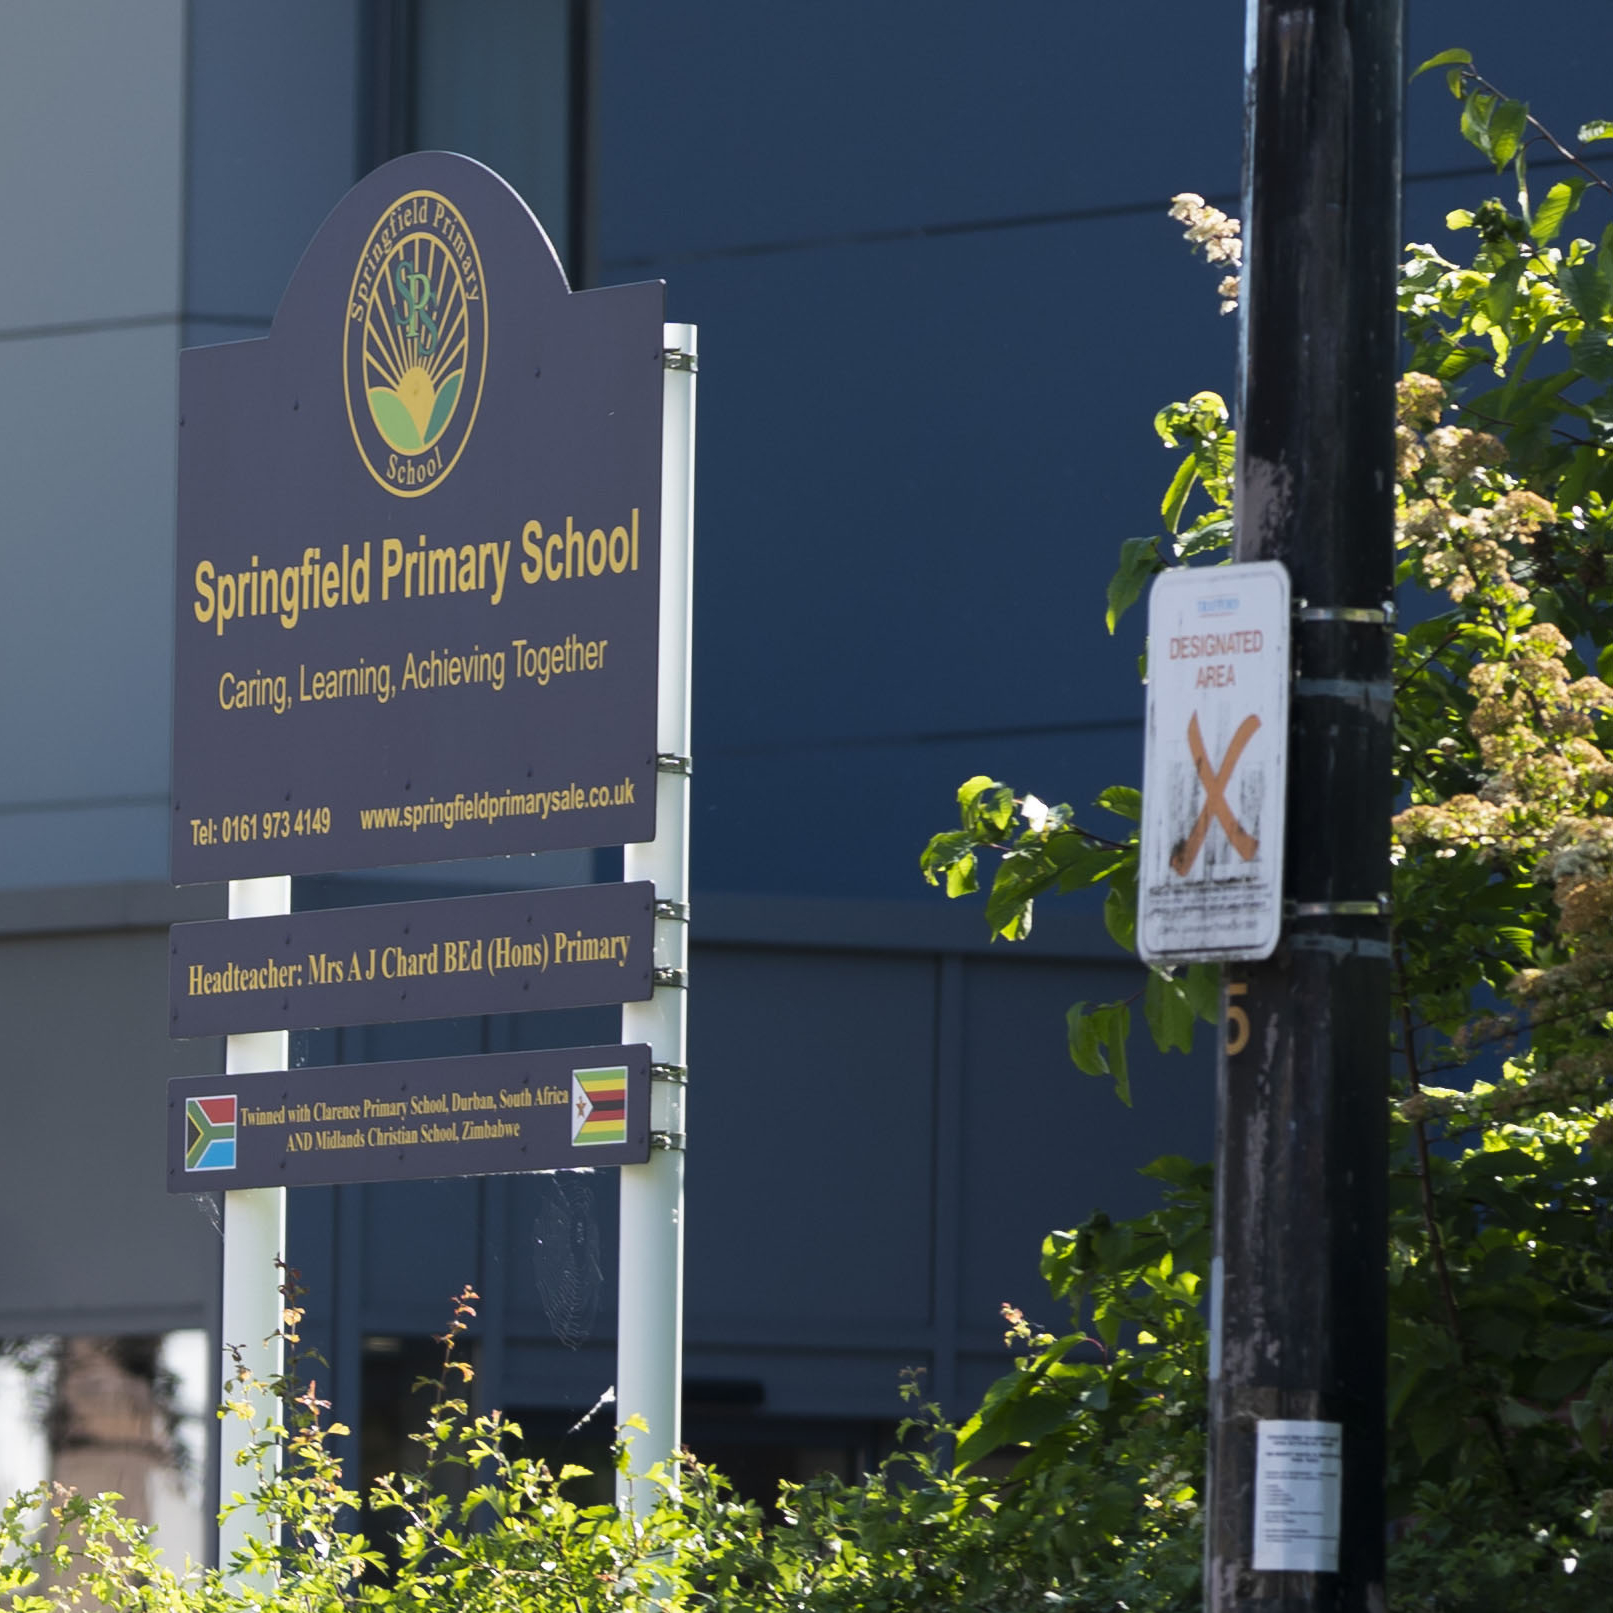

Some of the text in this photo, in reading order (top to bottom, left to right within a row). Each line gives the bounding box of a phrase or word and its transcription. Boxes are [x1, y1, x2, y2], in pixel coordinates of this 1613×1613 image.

[351, 197, 480, 323] Springfield Primary
[387, 447, 443, 486] School
[194, 507, 640, 636] Springfield Primary School
[1169, 629, 1264, 661] DESIGNATED
[218, 633, 608, 715] Caring, Learning, Achieving Together
[1195, 664, 1236, 689] AREA
[190, 777, 636, 846] Tel: 0161 973 4149 www.springfieldprimarysale.co.uk
[188, 930, 630, 996] Headteacher: Mrs A J Chard BEd (Hons) Primary
[240, 1086, 569, 1126] Twinned with Clarence Primary School, Durban, South Africa
[286, 1119, 520, 1152] AND Midlands Christian School, Zimbabwe
